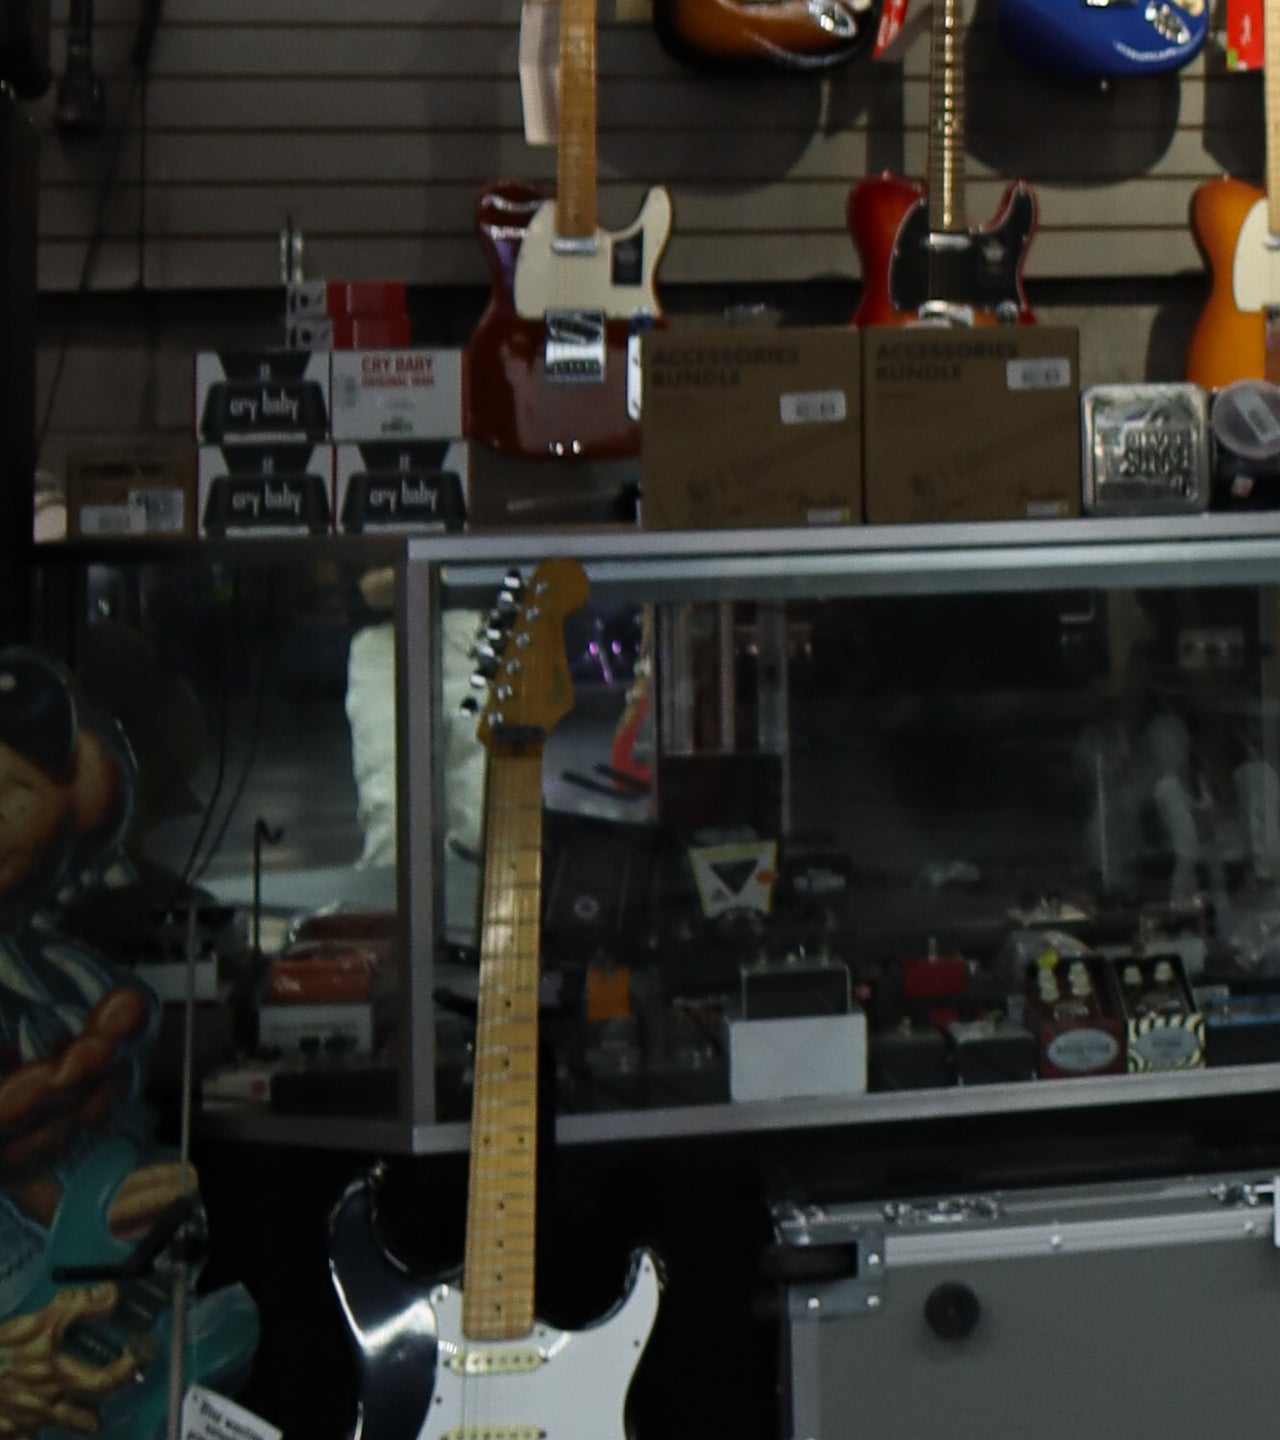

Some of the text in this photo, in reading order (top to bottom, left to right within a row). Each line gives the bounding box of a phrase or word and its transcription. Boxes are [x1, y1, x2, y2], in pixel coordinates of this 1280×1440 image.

[652, 346, 800, 367] ACCESSORIES
[876, 341, 1020, 360] ACCESSORIES
[361, 353, 436, 373] CRY BABY
[875, 363, 964, 383] BUNDLE
[652, 368, 742, 388] BUNDLE
[229, 386, 301, 423] cry baby
[232, 480, 303, 518] cry baby
[368, 477, 439, 514] cry baby
